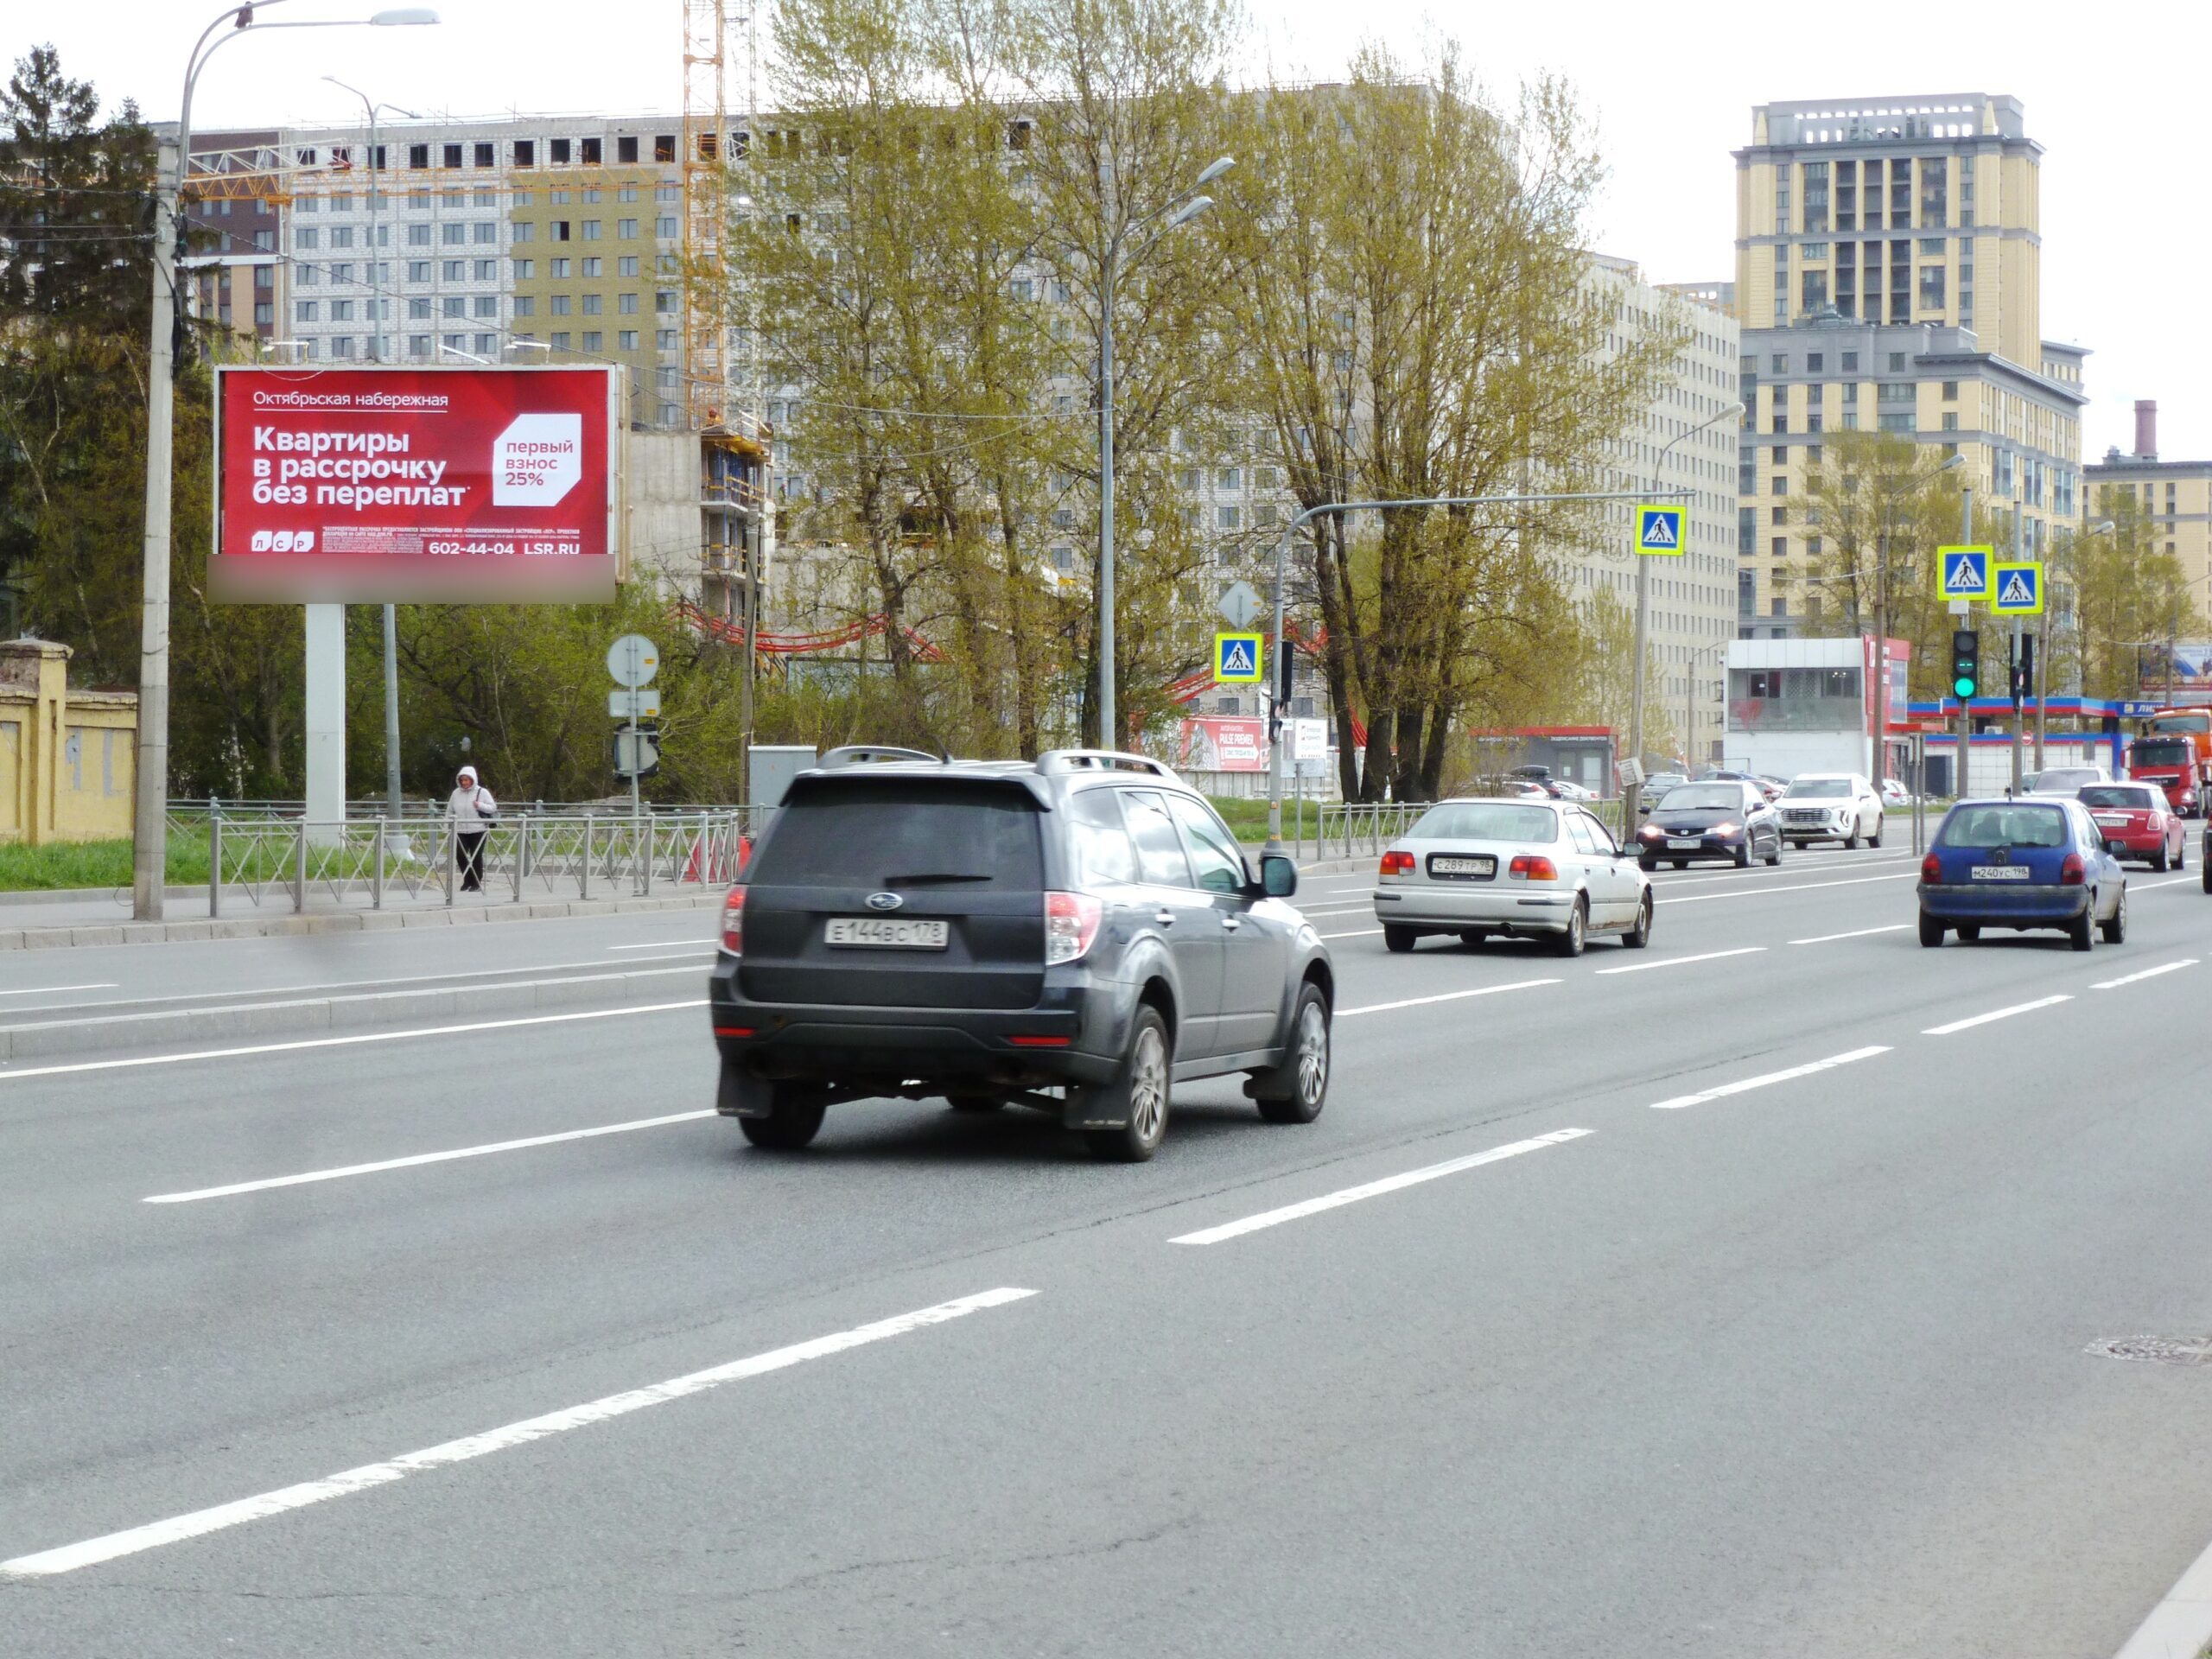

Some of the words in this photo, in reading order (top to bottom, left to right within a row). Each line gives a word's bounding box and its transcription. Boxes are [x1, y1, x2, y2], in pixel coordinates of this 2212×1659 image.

[253, 391, 350, 407] Октябрьская
[355, 392, 448, 409] набережная
[254, 426, 409, 458] Квартиры
[506, 440, 573, 456] первый
[253, 459, 271, 477] в
[281, 459, 447, 485] рассрочку
[505, 459, 557, 469] взнос
[505, 472, 544, 486] 25%
[252, 479, 308, 505] без
[429, 543, 515, 554] 602-44-04
[524, 543, 580, 554] LSR.RU
